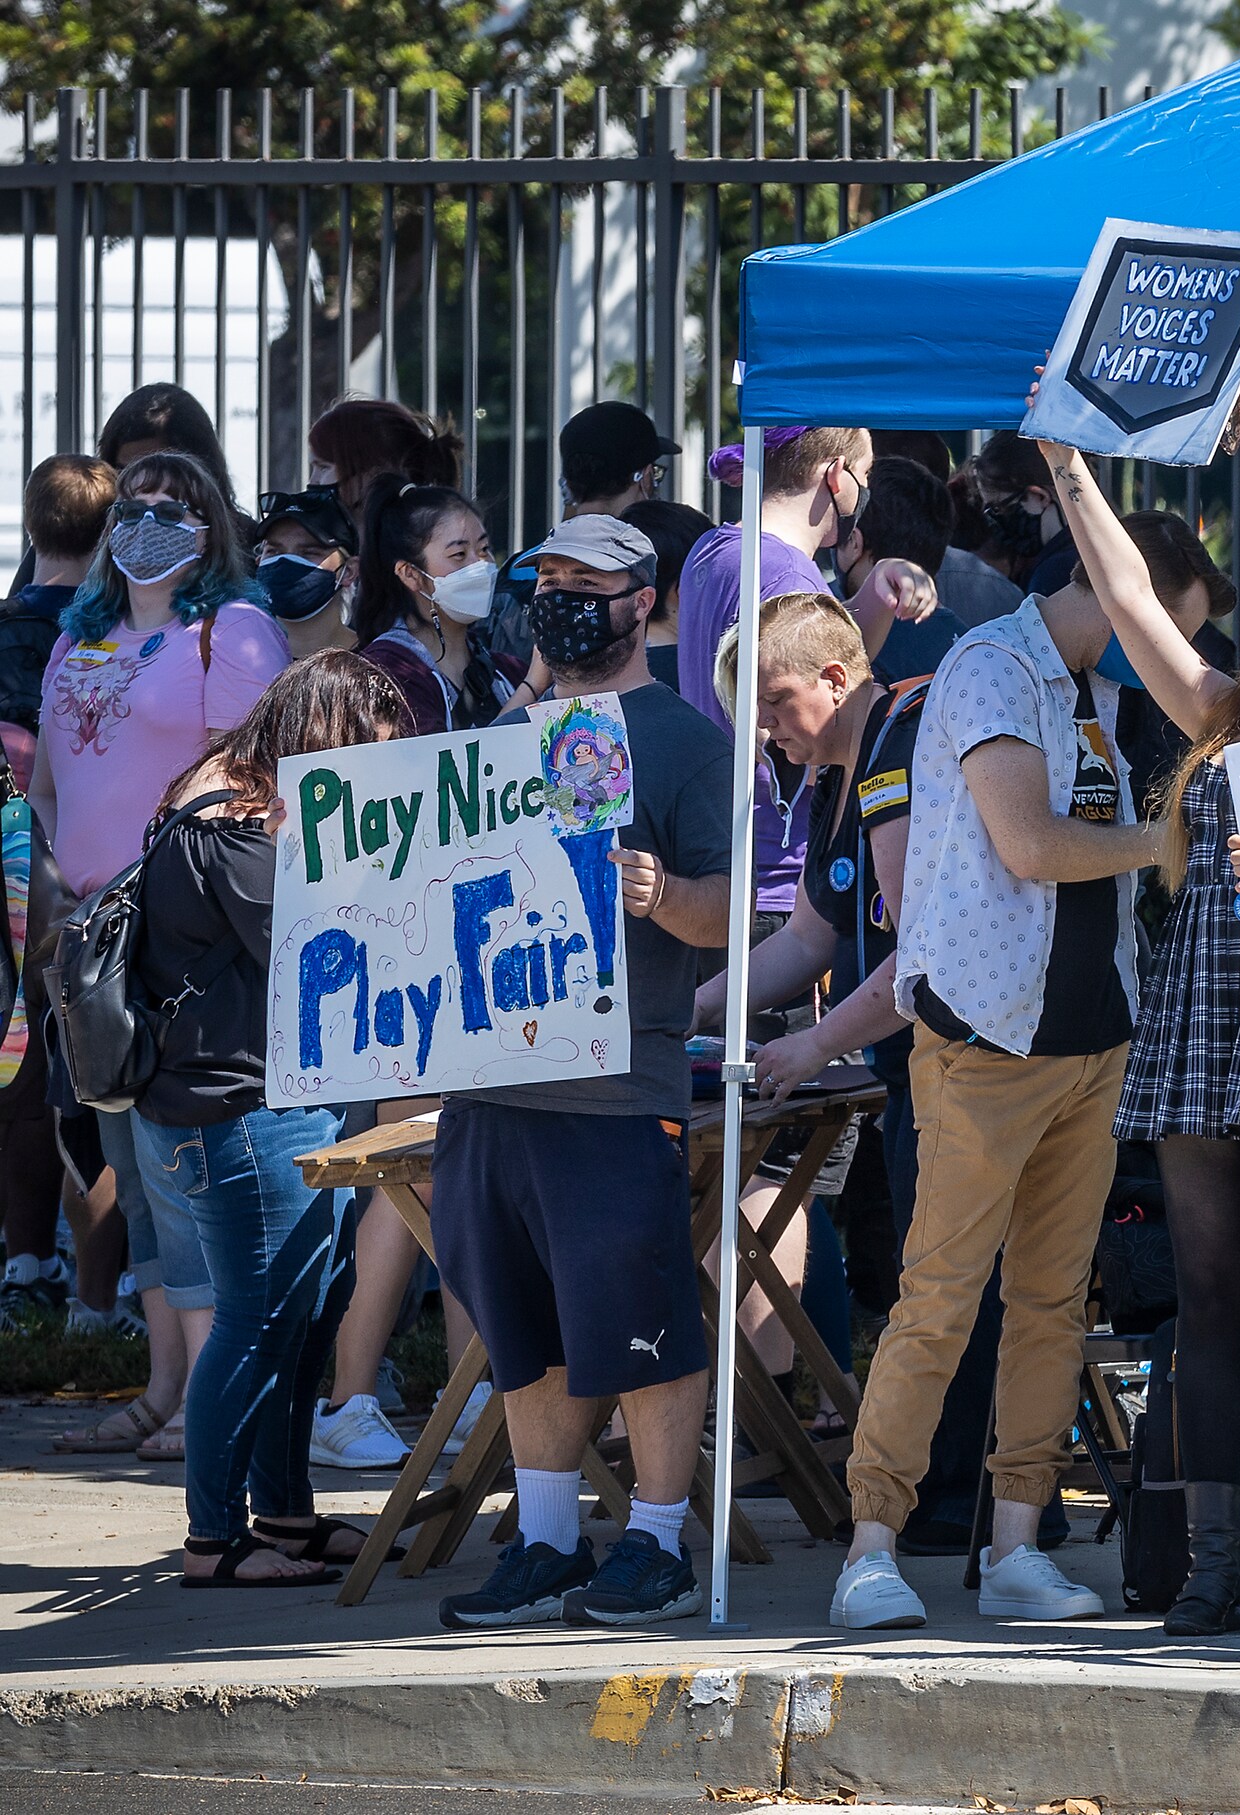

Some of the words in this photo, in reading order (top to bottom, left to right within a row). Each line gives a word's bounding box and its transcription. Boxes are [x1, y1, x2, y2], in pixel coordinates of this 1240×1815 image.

[1126, 259, 1240, 302] WOMENS
[1120, 302, 1215, 345] VOICES
[1091, 343, 1208, 387] MATTER!
[861, 777, 885, 792] hello
[299, 768, 423, 884] Play
[438, 740, 545, 847] Nice
[299, 928, 442, 1076] Play
[452, 830, 618, 1034] Fair!
